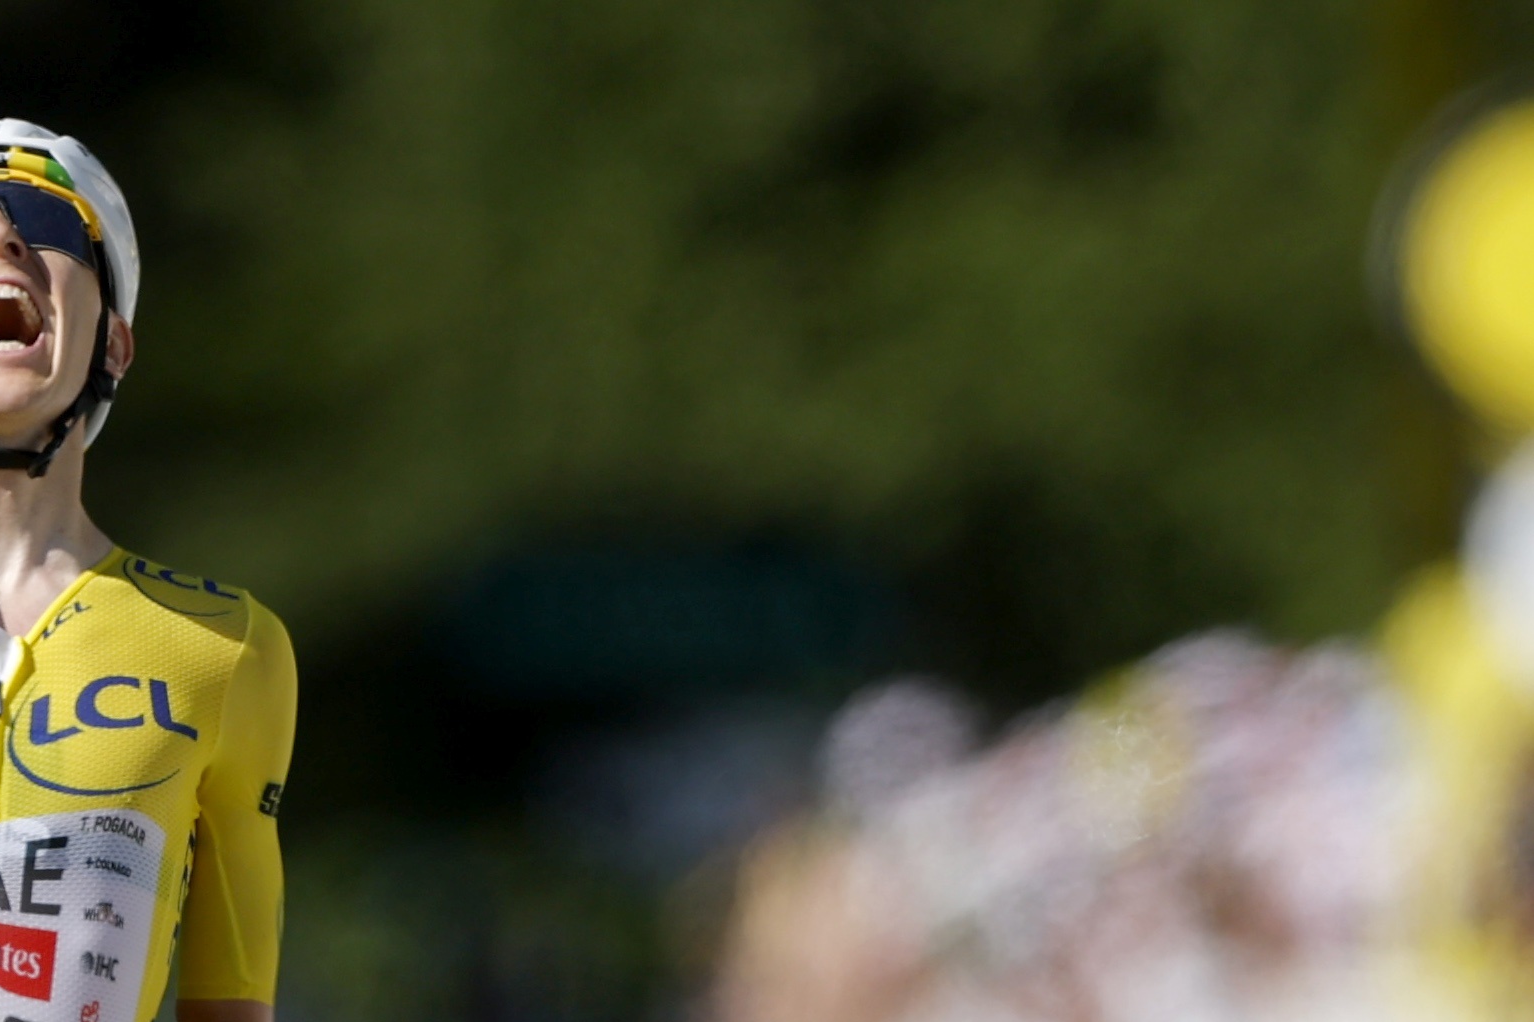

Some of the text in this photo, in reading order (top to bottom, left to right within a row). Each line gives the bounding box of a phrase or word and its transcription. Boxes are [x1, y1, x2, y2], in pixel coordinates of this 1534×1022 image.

[134, 559, 239, 601] LCL
[42, 601, 92, 640] LCL
[28, 675, 198, 747] LCL
